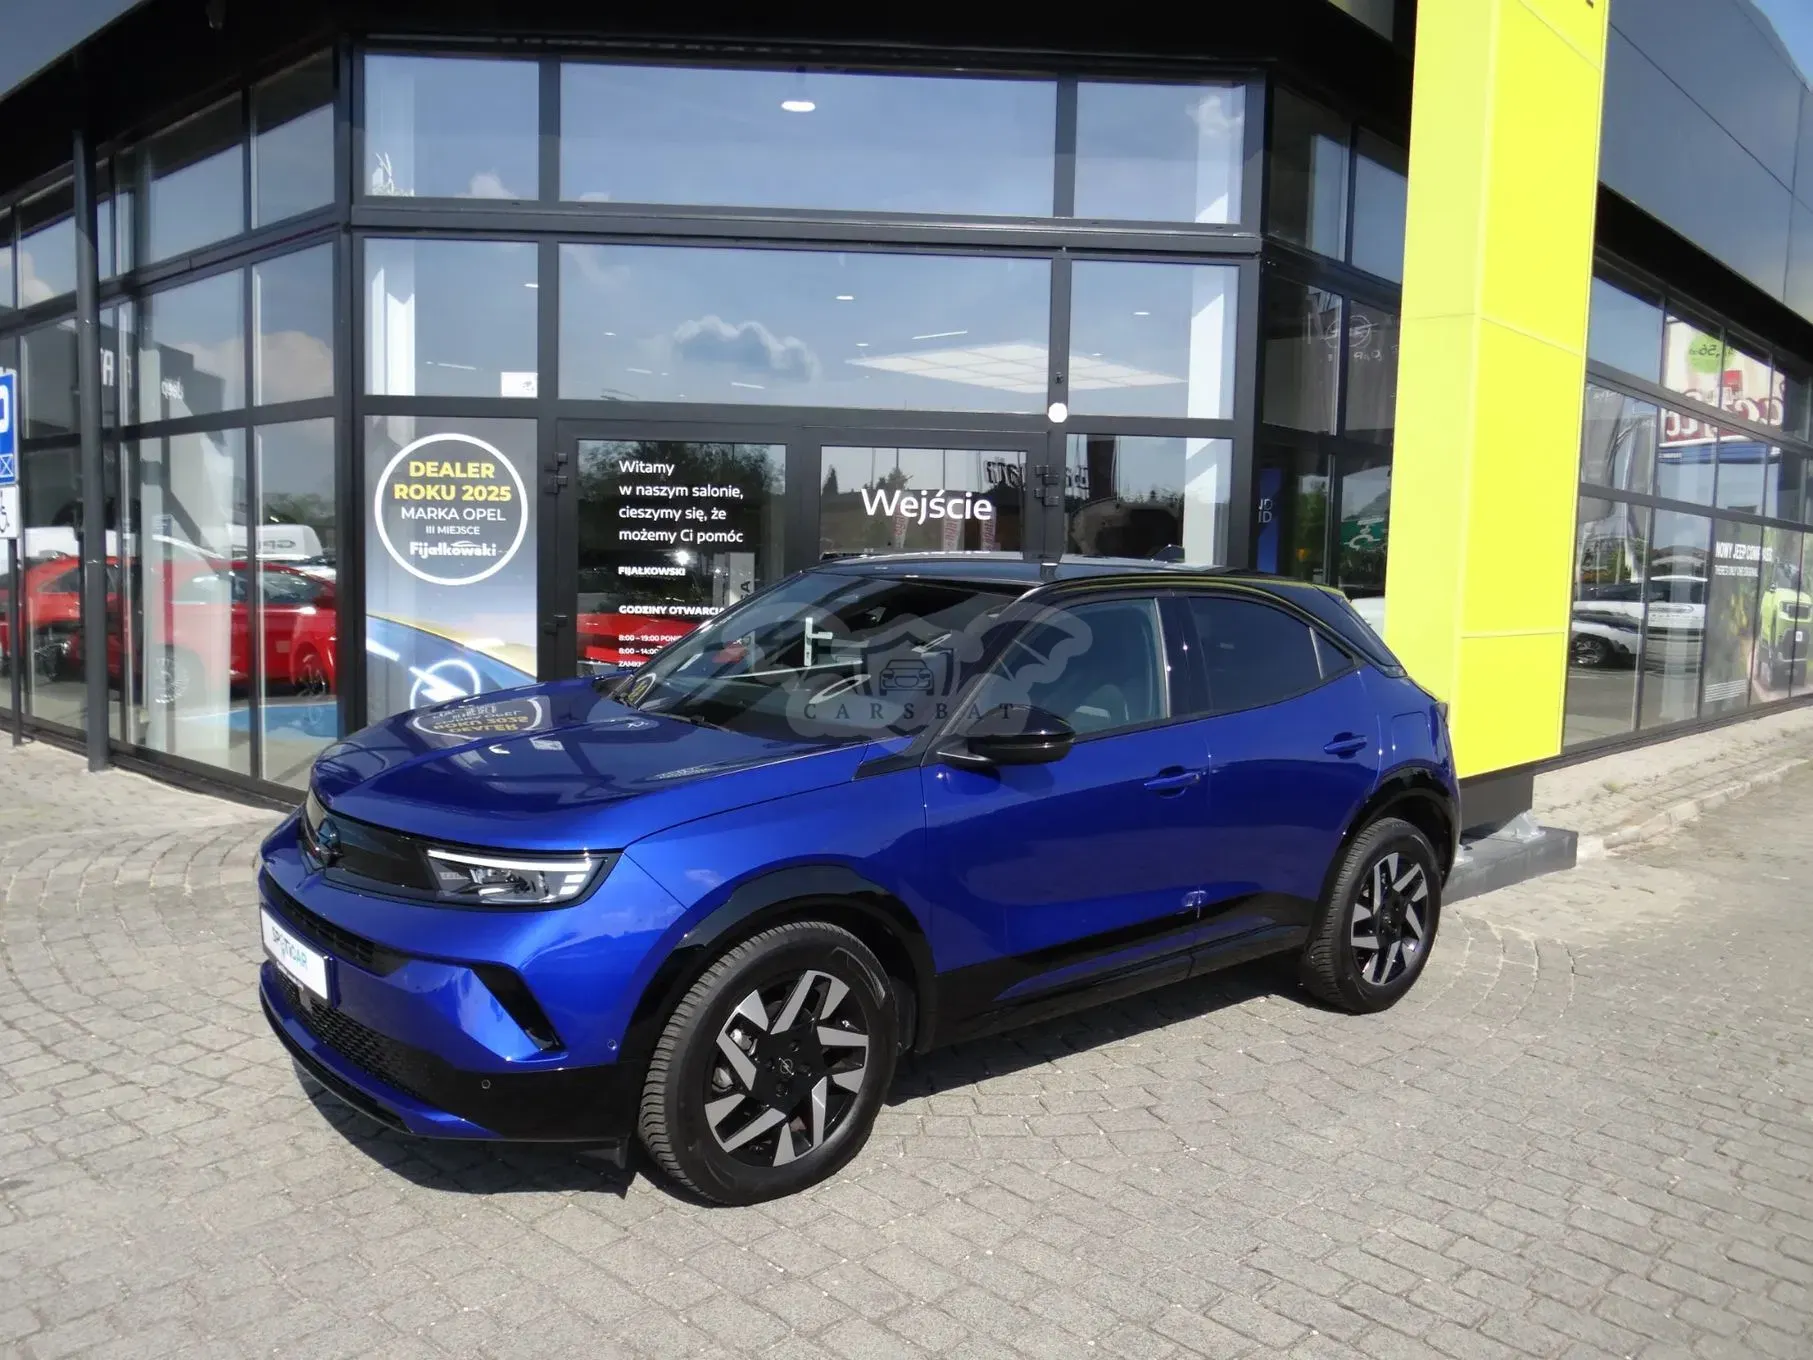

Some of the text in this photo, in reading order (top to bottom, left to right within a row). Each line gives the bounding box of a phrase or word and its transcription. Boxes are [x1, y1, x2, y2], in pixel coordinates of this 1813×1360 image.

[409, 461, 495, 478] DEALER
[619, 460, 675, 476] Witamy
[394, 483, 512, 502] ROKU 2025
[619, 483, 744, 500] w naszym salonie,
[401, 506, 506, 521] MARKA OPEL
[619, 505, 727, 522] cieszymy się, że
[861, 488, 993, 525] Wejście
[425, 525, 481, 536] III MIEJSCE
[619, 528, 744, 545] możemy Ci pomóc
[619, 605, 667, 615] GODZINY
